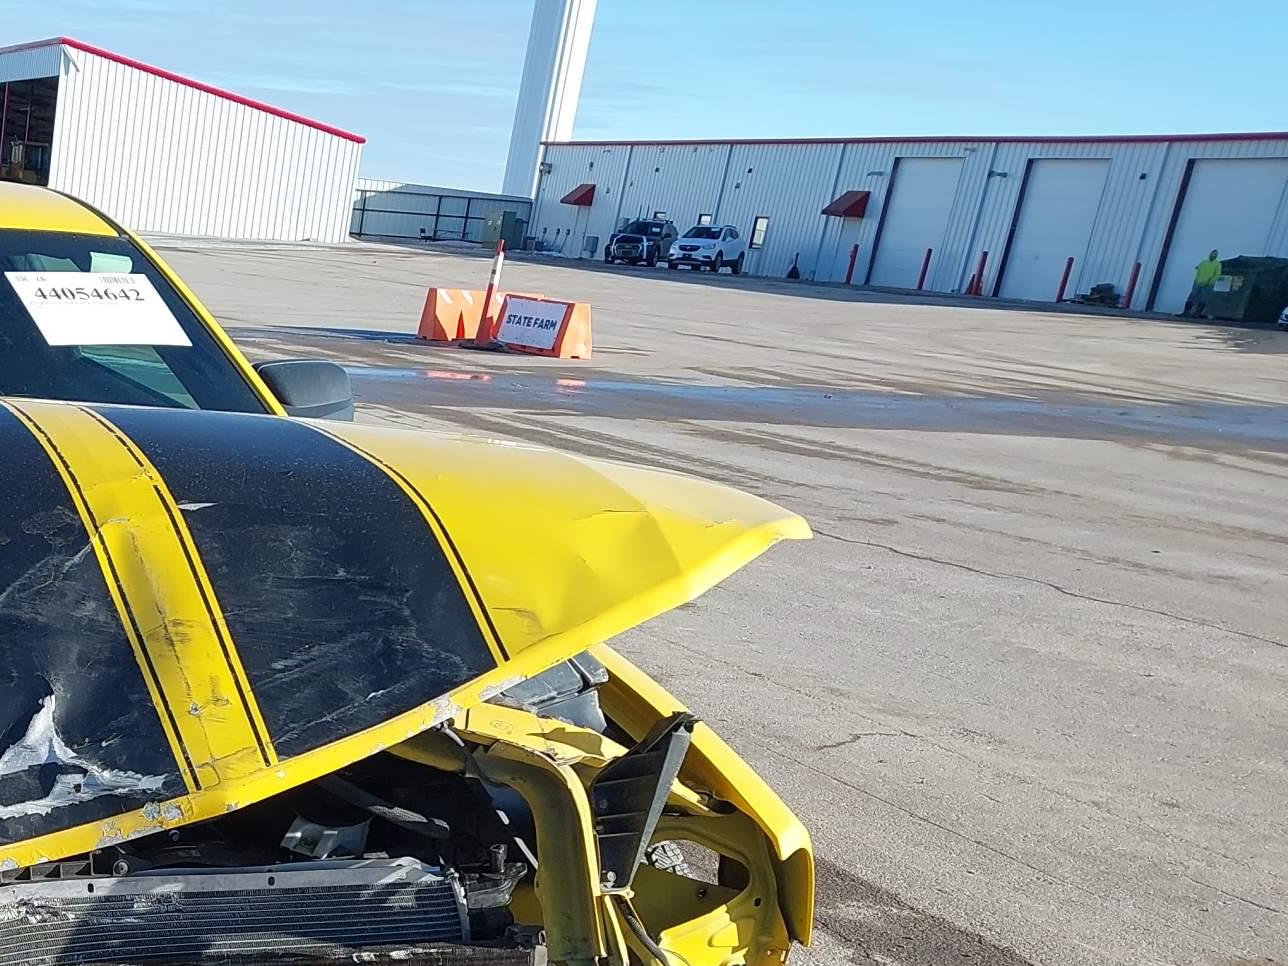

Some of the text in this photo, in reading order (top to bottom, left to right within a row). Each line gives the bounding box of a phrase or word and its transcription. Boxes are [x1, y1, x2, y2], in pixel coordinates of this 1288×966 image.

[34, 287, 145, 301] 44054642
[506, 314, 558, 331] STATE FARM
